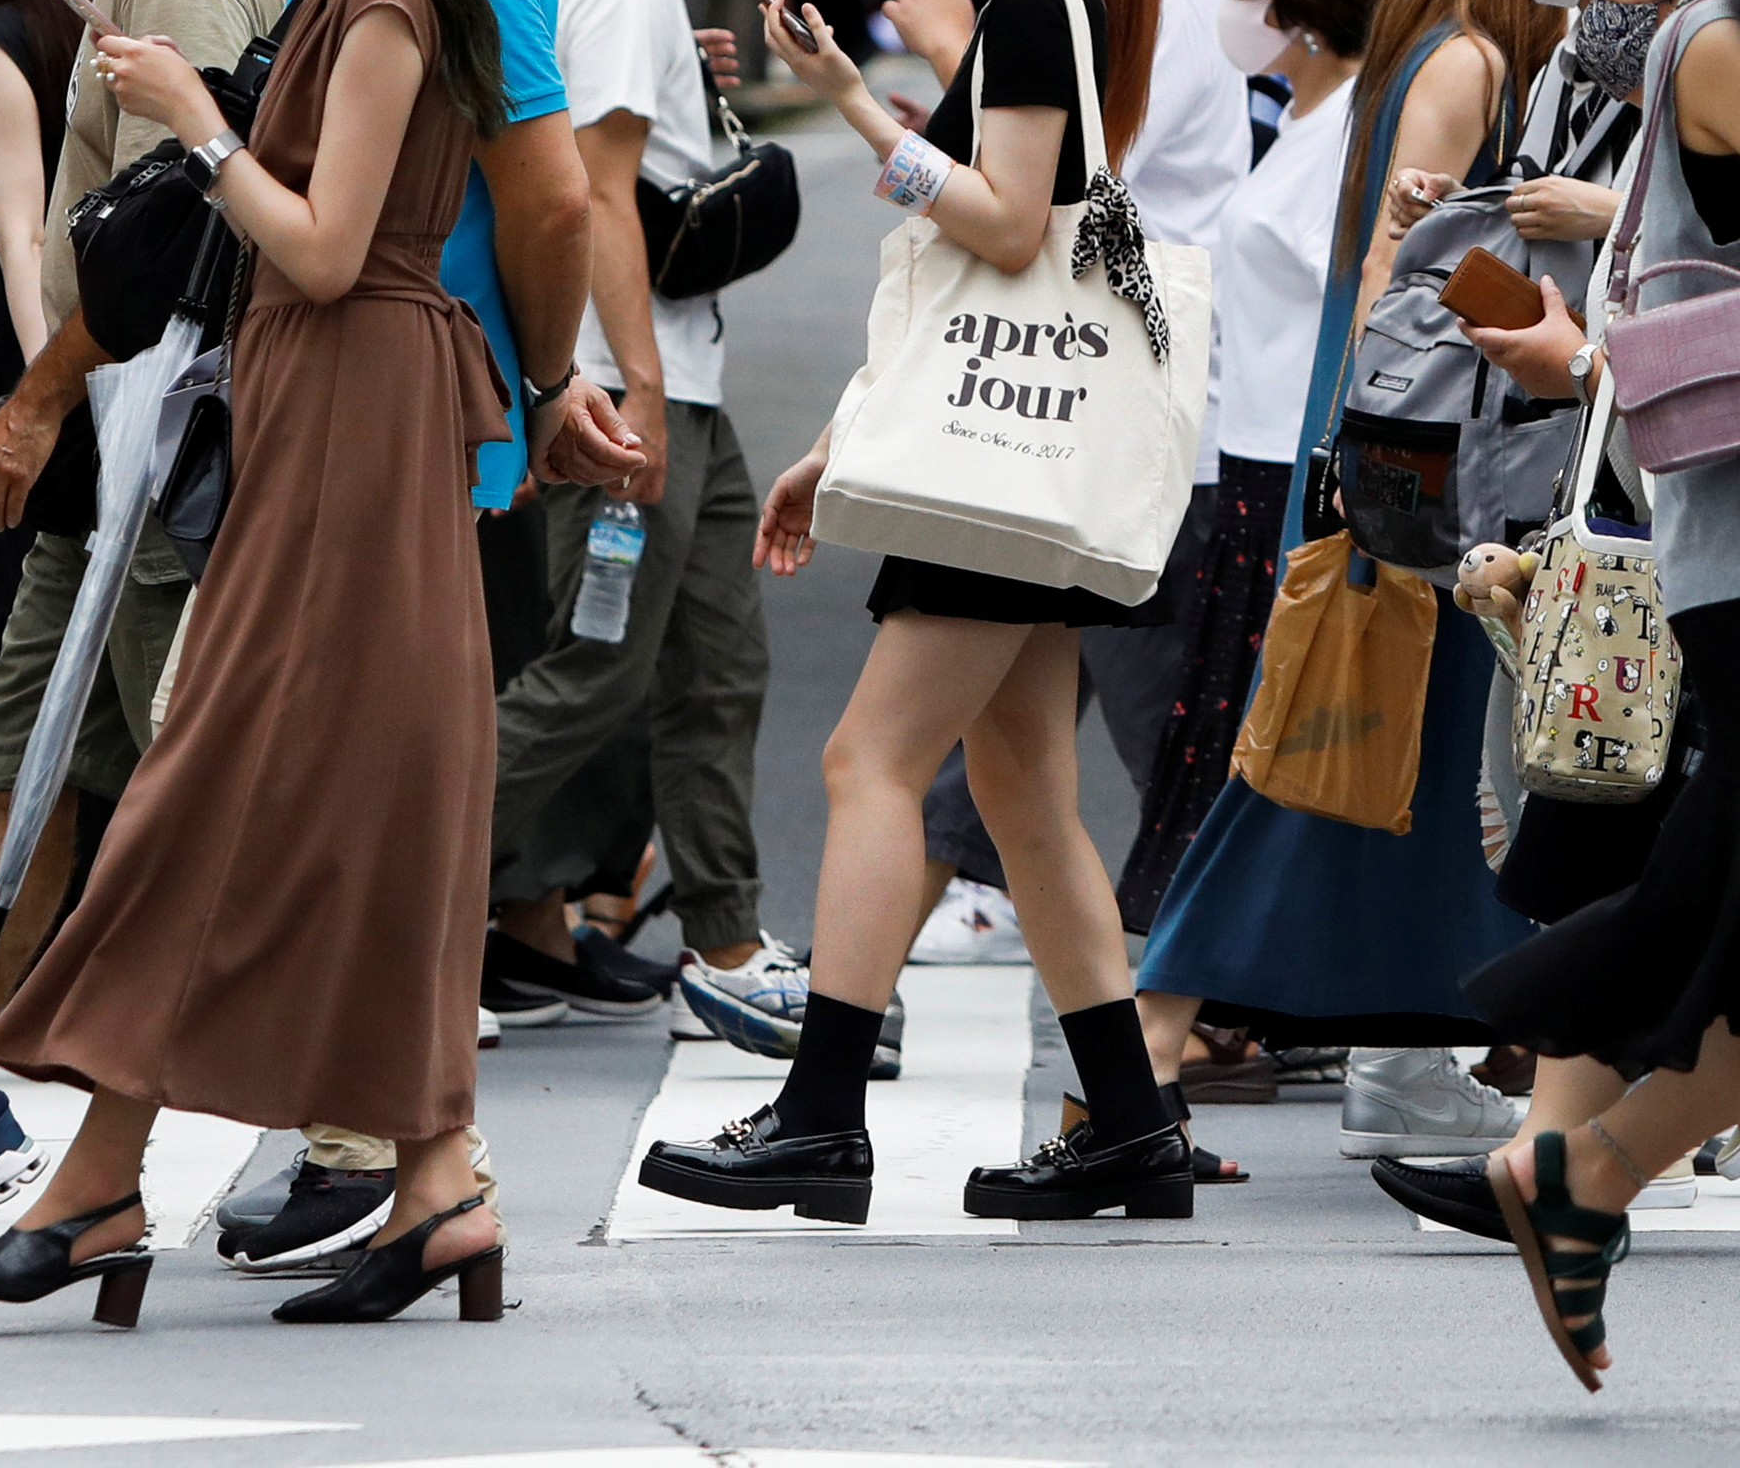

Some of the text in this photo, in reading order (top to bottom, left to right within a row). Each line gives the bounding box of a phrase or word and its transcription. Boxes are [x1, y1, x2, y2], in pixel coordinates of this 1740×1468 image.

[943, 311, 1109, 361] après
[947, 357, 1088, 423] jour
[941, 418, 978, 441] Since
